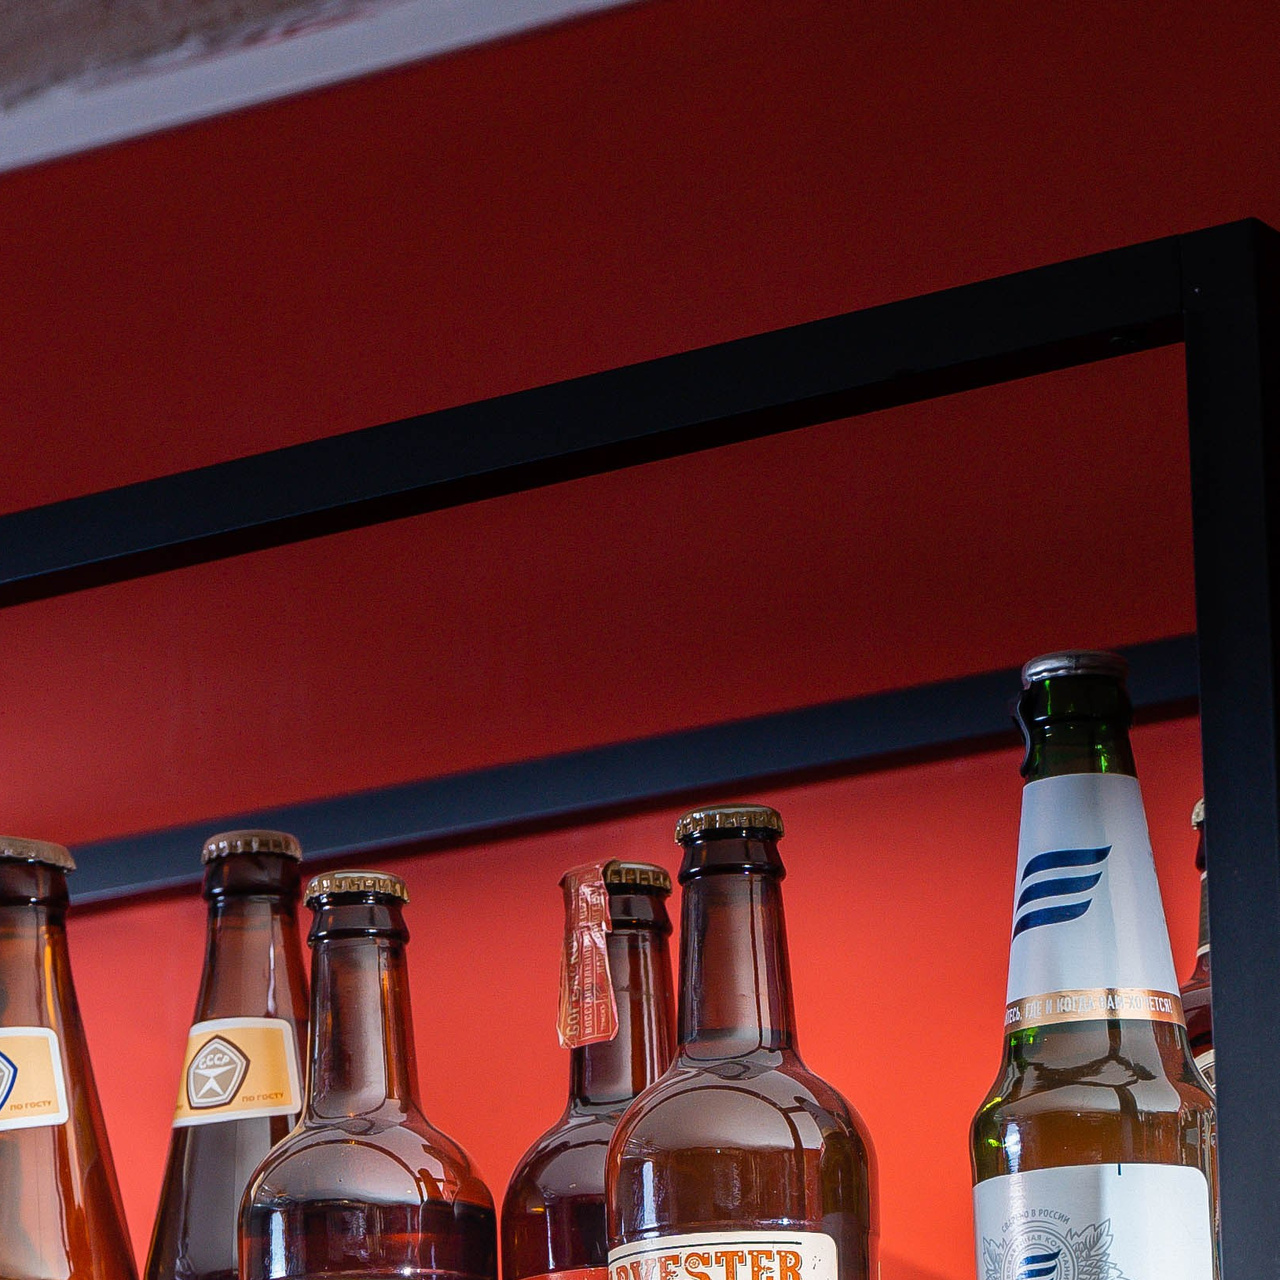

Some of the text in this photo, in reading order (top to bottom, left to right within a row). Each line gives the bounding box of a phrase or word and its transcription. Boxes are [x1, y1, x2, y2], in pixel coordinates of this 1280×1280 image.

[1045, 999, 1052, 1014] И
[198, 1054, 230, 1069] СССР
[24, 1100, 53, 1110] ГОСТУ
[1038, 1208, 1071, 1225] РОССИИ
